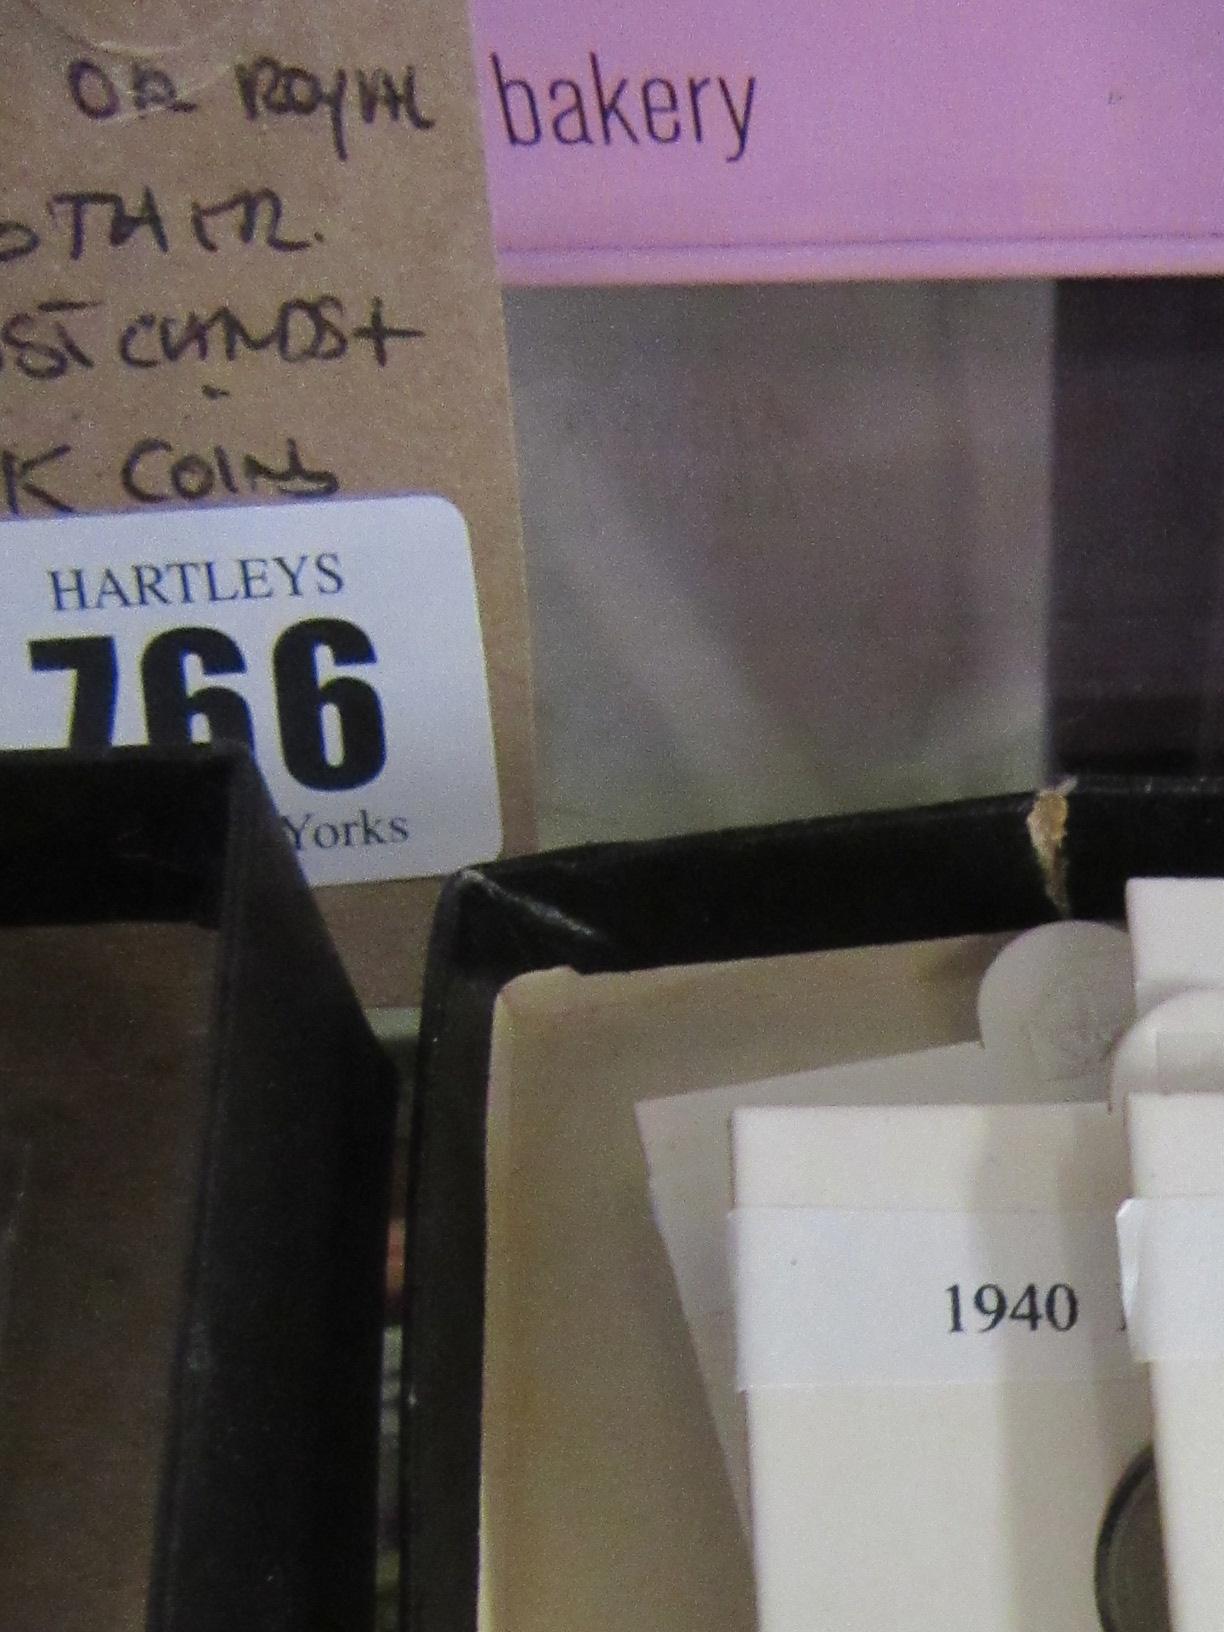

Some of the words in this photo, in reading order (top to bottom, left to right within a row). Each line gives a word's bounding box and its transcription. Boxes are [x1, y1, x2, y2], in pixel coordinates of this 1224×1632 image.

[488, 50, 758, 163] bakery
[48, 551, 347, 612] HARTLEYS
[26, 616, 388, 793] 766
[279, 807, 410, 852] Yorks
[945, 1282, 1079, 1334] 1940
